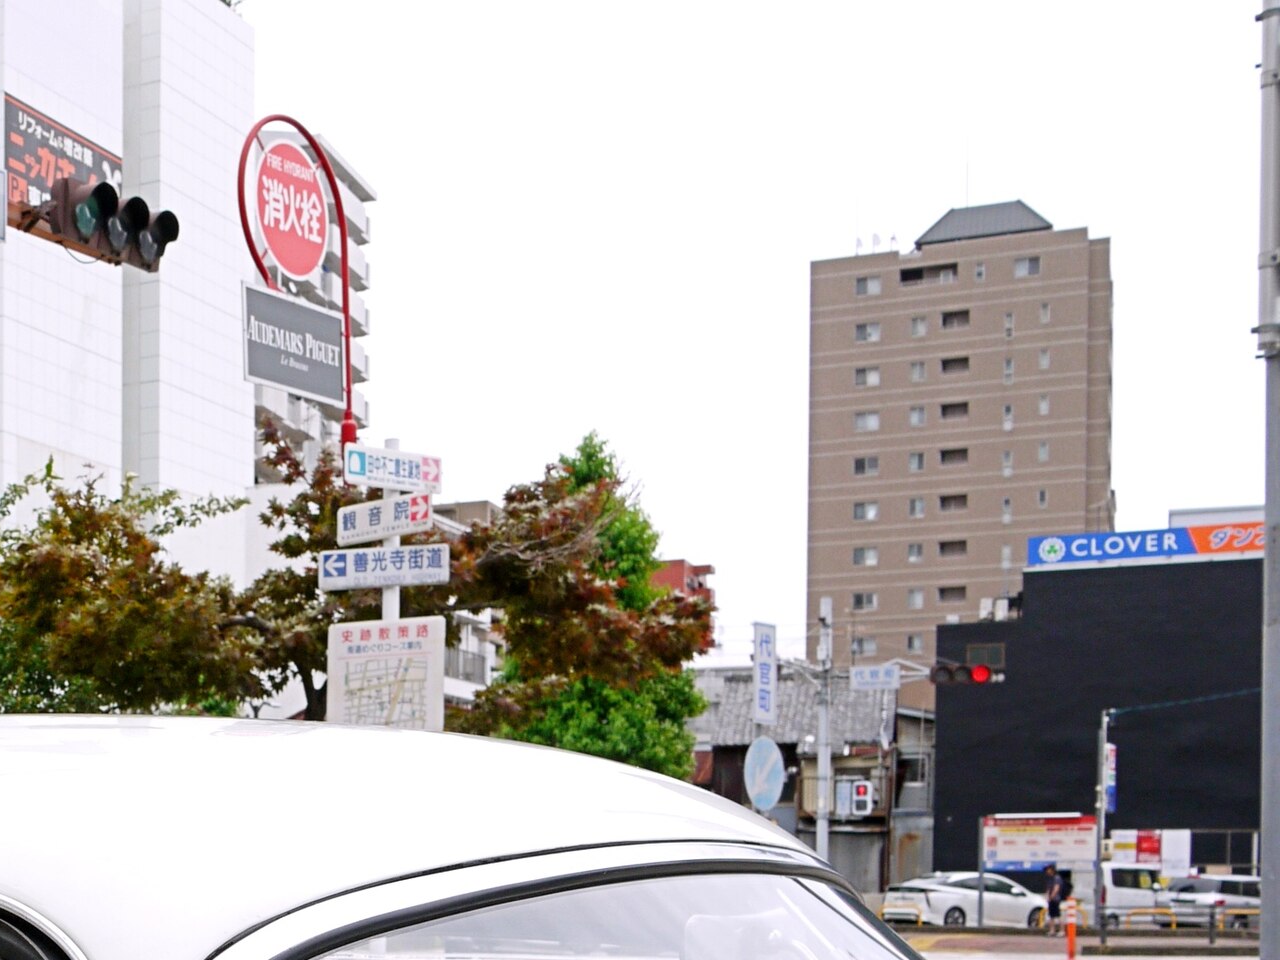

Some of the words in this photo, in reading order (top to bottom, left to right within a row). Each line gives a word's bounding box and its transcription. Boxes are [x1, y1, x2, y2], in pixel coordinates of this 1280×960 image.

[267, 153, 282, 171] FIRE
[283, 159, 314, 183] HYDRANT
[262, 175, 322, 243] 消火栓
[247, 315, 304, 356] AUDEMARS
[305, 333, 340, 367] PIGUET
[343, 501, 409, 531] 観音院
[1071, 533, 1178, 556] CLOVER
[353, 550, 443, 573] 善光寺街道
[341, 624, 429, 644] 史跡散策路
[758, 634, 771, 712] 代官町
